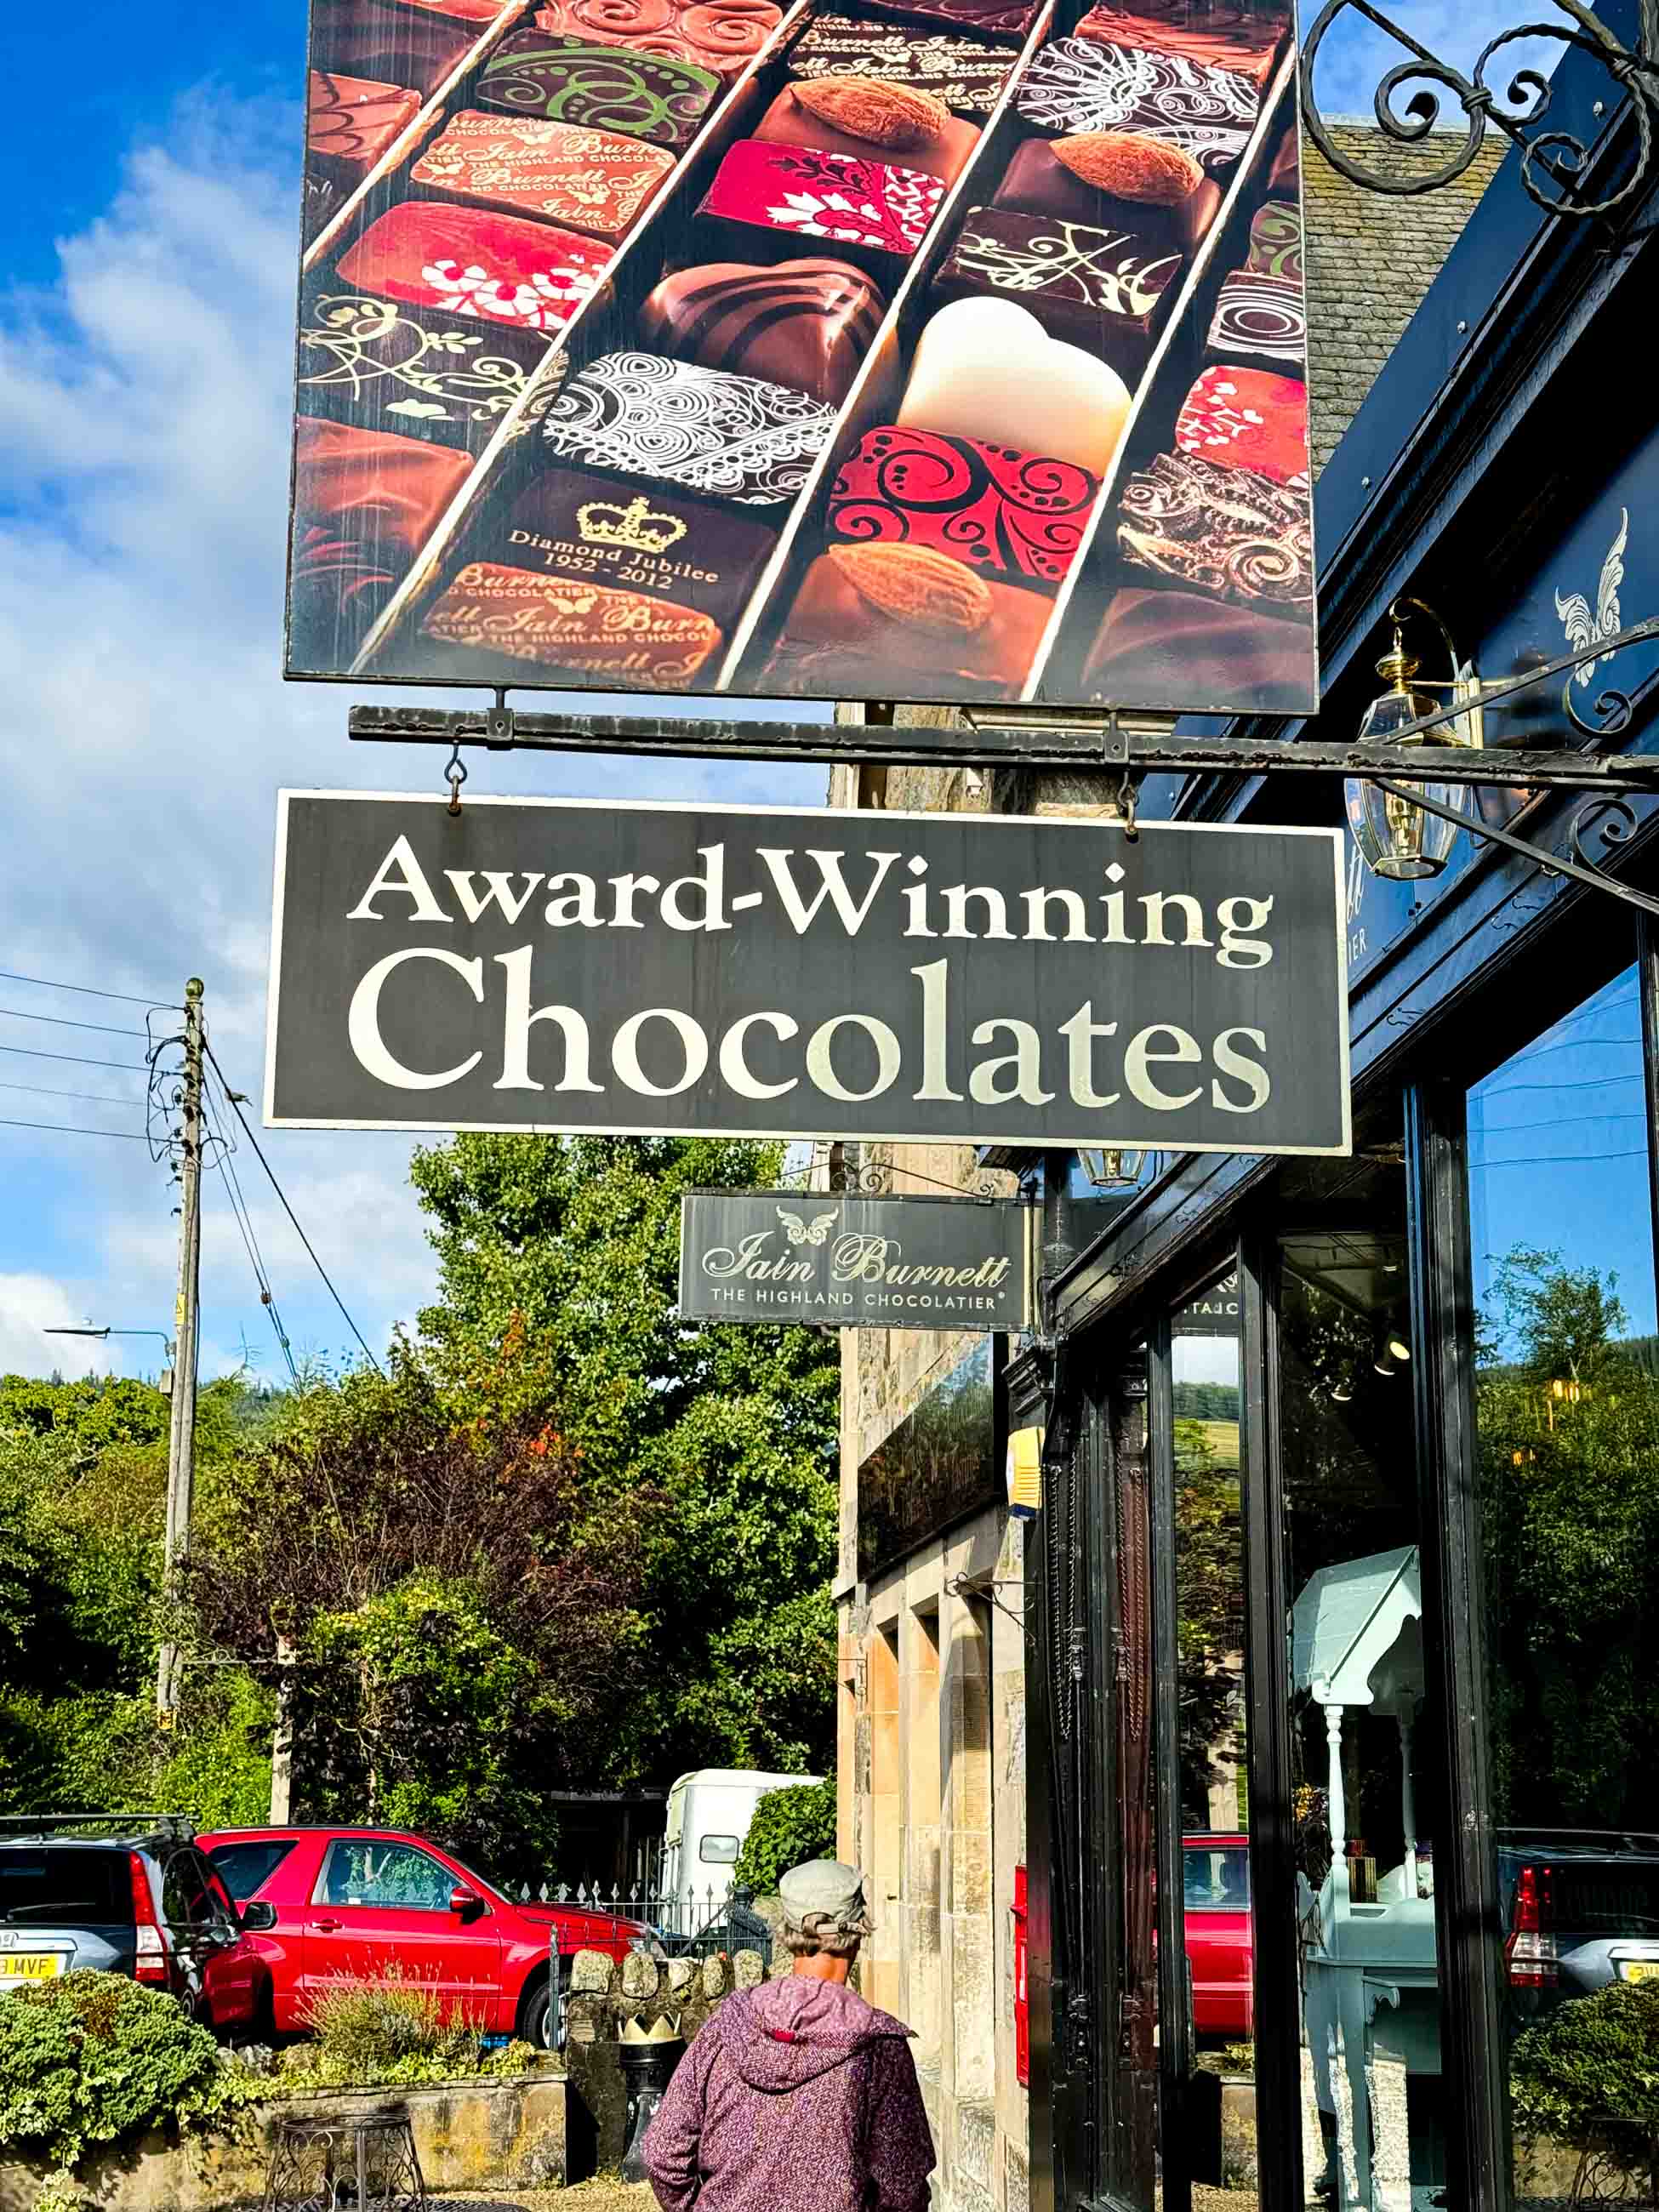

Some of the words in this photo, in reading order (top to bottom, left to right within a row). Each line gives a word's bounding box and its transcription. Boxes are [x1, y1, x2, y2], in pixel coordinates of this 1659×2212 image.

[508, 529, 623, 562] Diamond
[629, 552, 720, 583] Jubilee
[544, 553, 596, 573] 1952
[616, 566, 673, 590] 2012
[345, 834, 1275, 970] Award-Winning
[347, 944, 1269, 1115] Chocolates
[702, 1230, 816, 1284] Iain
[831, 1232, 1012, 1288] Burnett
[712, 1288, 745, 1302] THE
[756, 1290, 853, 1306] HIGHLAND
[14, 1958, 49, 1975] MVF
